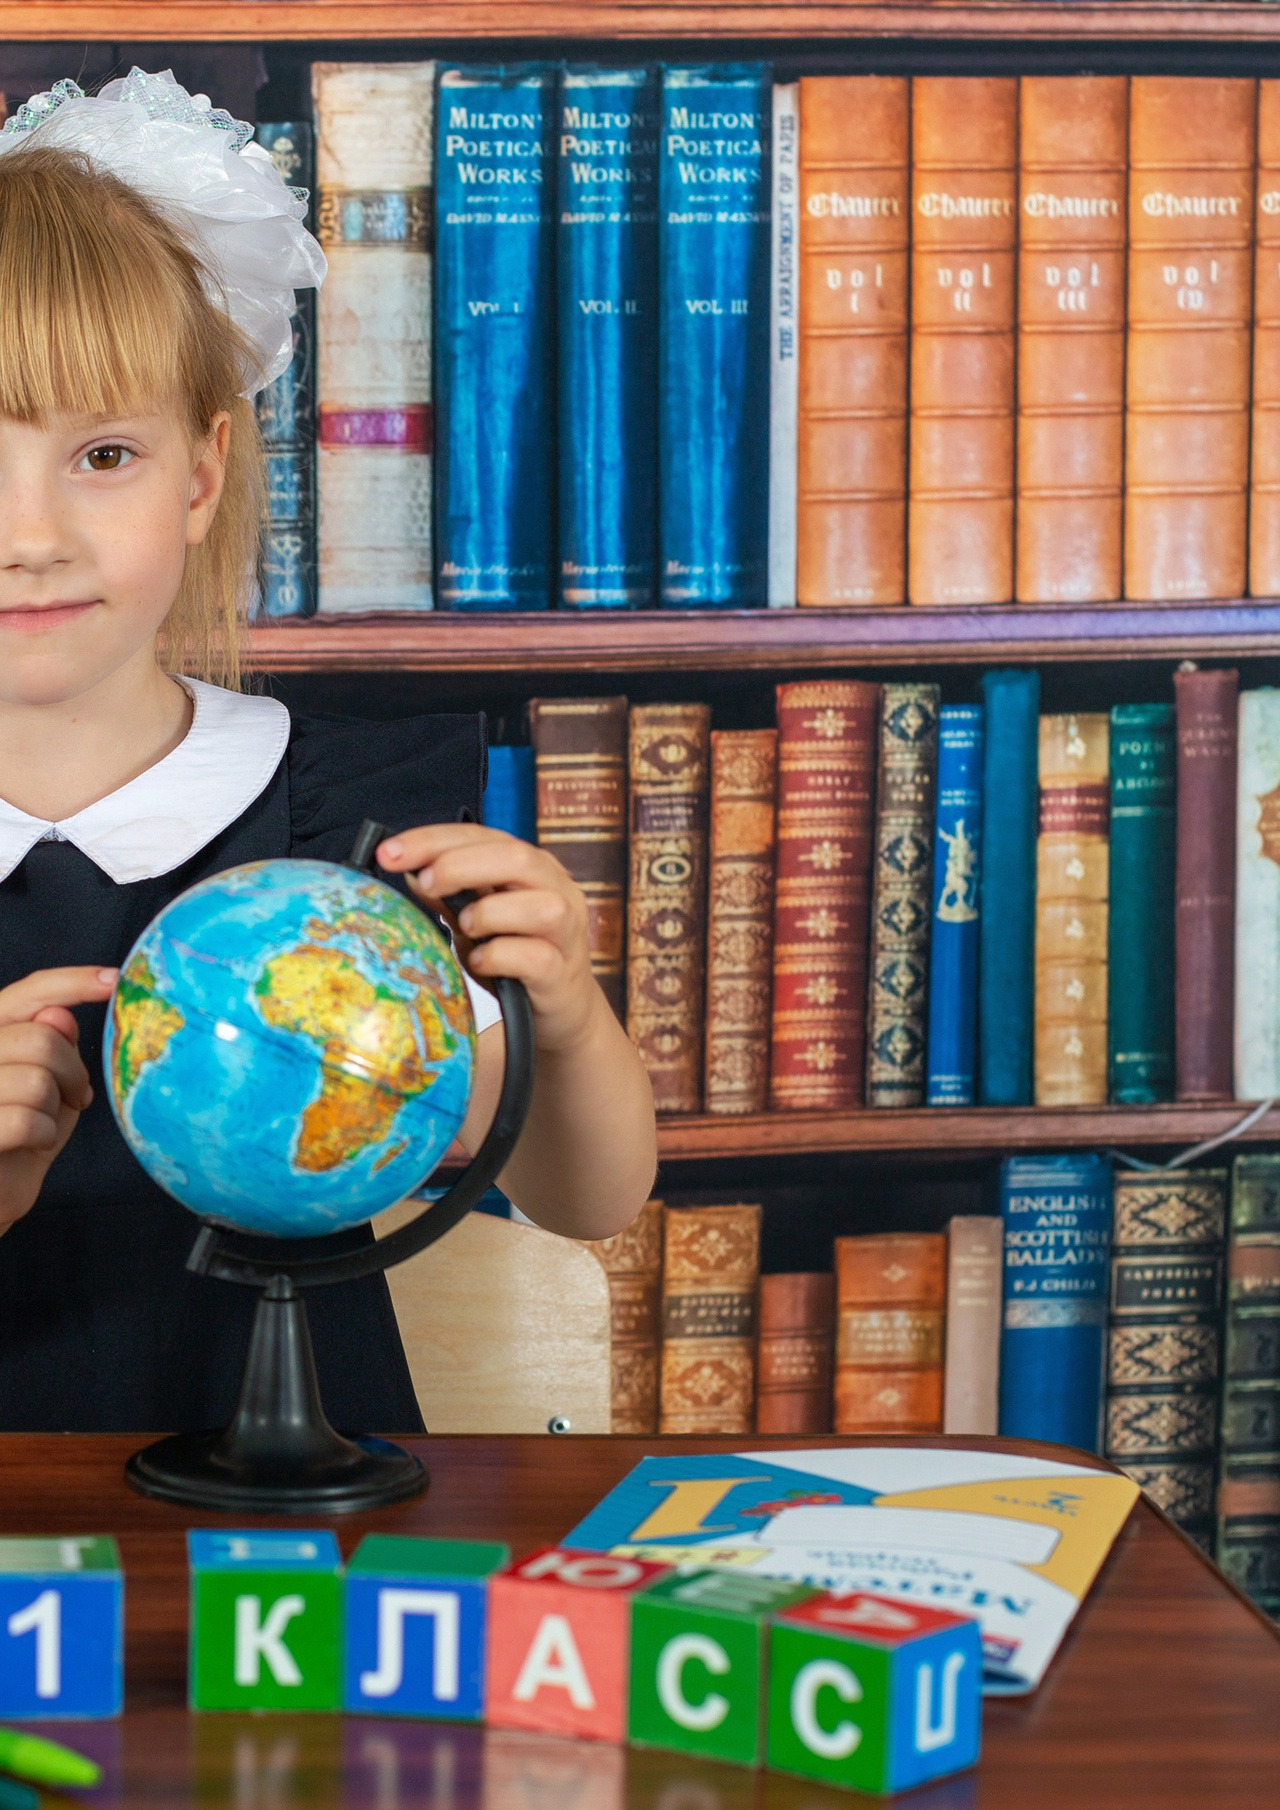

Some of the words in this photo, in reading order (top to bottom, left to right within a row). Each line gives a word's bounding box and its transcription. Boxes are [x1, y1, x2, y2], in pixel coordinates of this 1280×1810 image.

[457, 163, 543, 184] WORKS
[678, 163, 762, 184] WORKS
[1035, 1214, 1078, 1227] AND
[7, 1589, 62, 1699] 1
